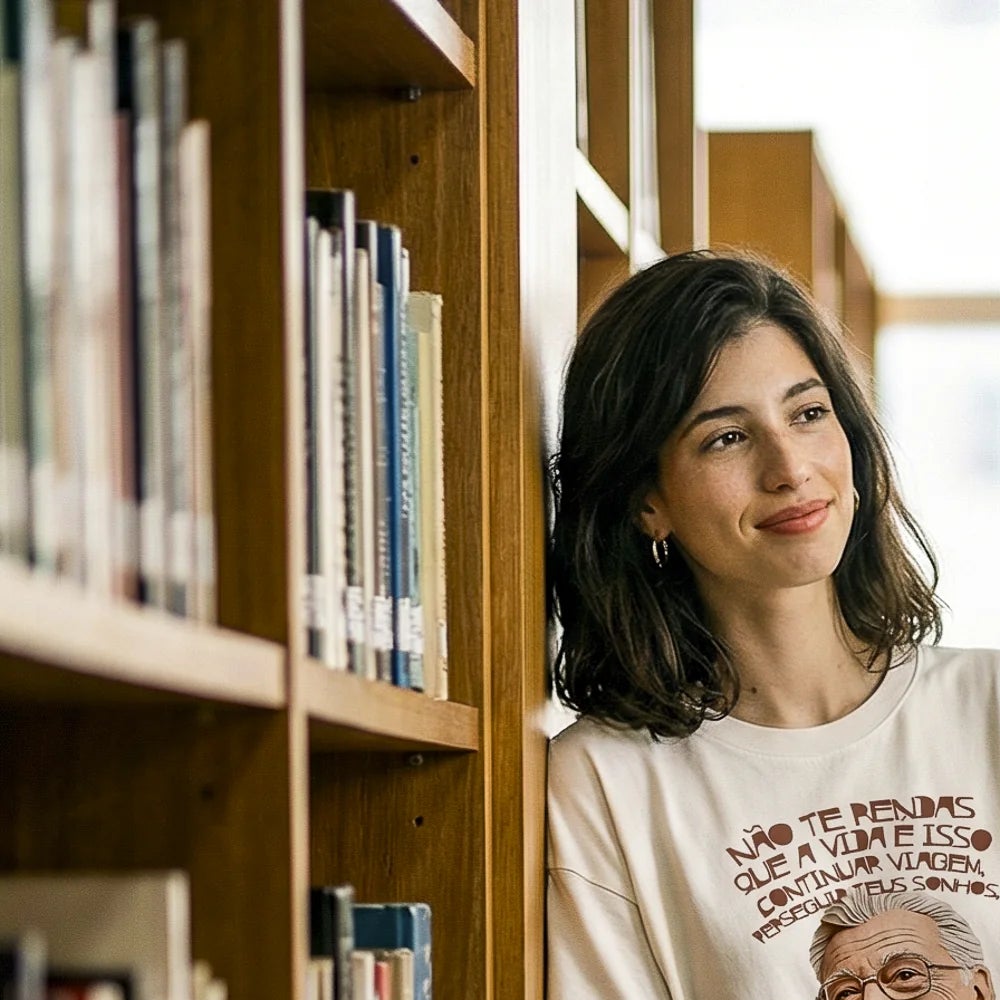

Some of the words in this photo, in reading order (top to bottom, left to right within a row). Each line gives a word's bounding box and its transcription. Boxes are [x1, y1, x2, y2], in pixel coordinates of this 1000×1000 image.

[726, 823, 793, 867] NÃO
[799, 807, 846, 836] TE
[850, 796, 976, 826] RENDAS
[734, 853, 791, 895] QUE
[798, 842, 817, 868] A
[819, 827, 886, 858] VIDA
[922, 824, 992, 852] ISSO
[757, 855, 883, 918] CONTINUAR
[886, 852, 985, 877] VIAGEM,
[912, 875, 1000, 901] SONHOS,
